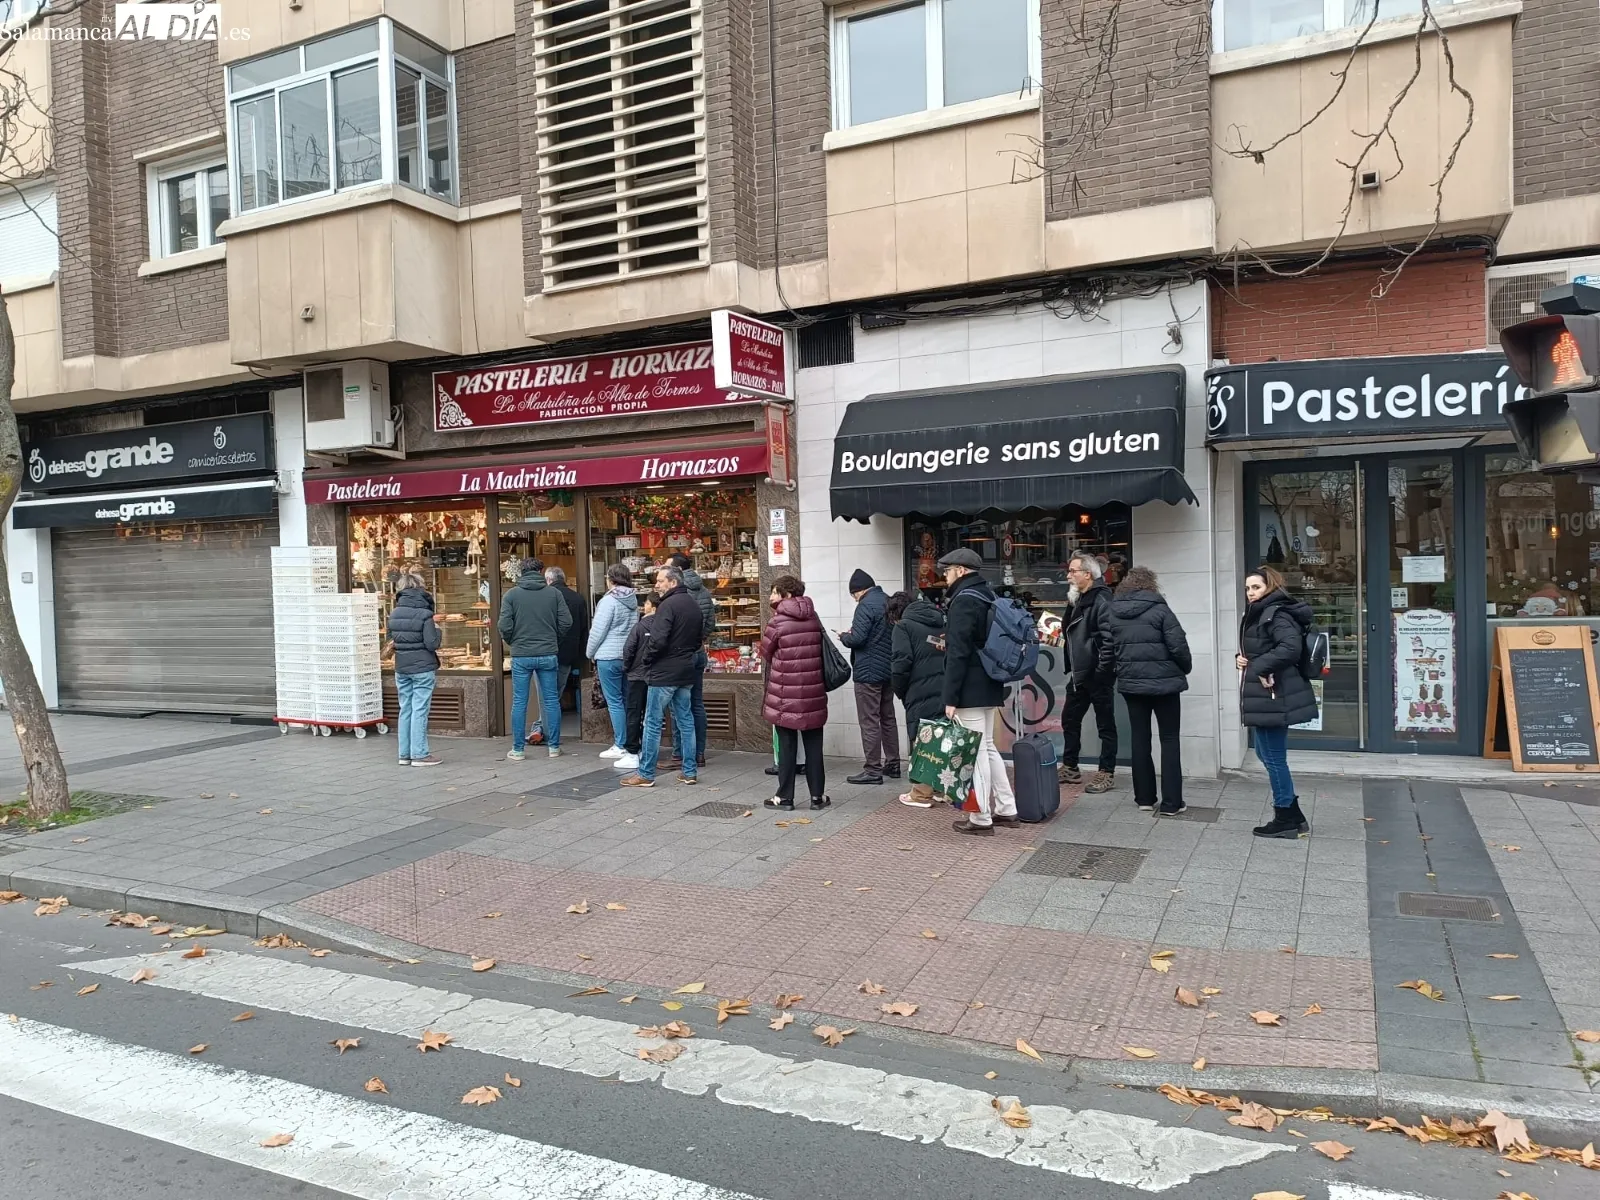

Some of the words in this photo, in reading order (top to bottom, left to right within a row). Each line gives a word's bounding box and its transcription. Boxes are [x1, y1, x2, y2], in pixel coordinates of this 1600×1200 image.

[730, 318, 782, 346] PASTELERIA
[454, 362, 588, 396] PASTELERIA
[610, 346, 714, 380] HORNAZ
[732, 370, 768, 390] HORNAZOS
[772, 380, 784, 394] PAN
[492, 394, 516, 414] La
[518, 392, 580, 412] Madrileña
[580, 394, 596, 408] de
[598, 384, 634, 404] Alba
[634, 386, 648, 400] de
[652, 376, 702, 398] Tormes
[540, 404, 604, 418] FABRICACION
[612, 402, 648, 412] PROPIA
[48, 460, 86, 474] dehesa
[86, 436, 174, 478] grande
[840, 442, 990, 474] Boulangerie
[1000, 438, 1062, 462] sans
[1068, 430, 1160, 462] gluten
[326, 476, 402, 500] Pastelería
[460, 474, 480, 492] La
[484, 466, 578, 490] Madrileña
[640, 456, 740, 480] Hornazos
[96, 508, 120, 520] dehesa
[120, 496, 176, 522] grande
